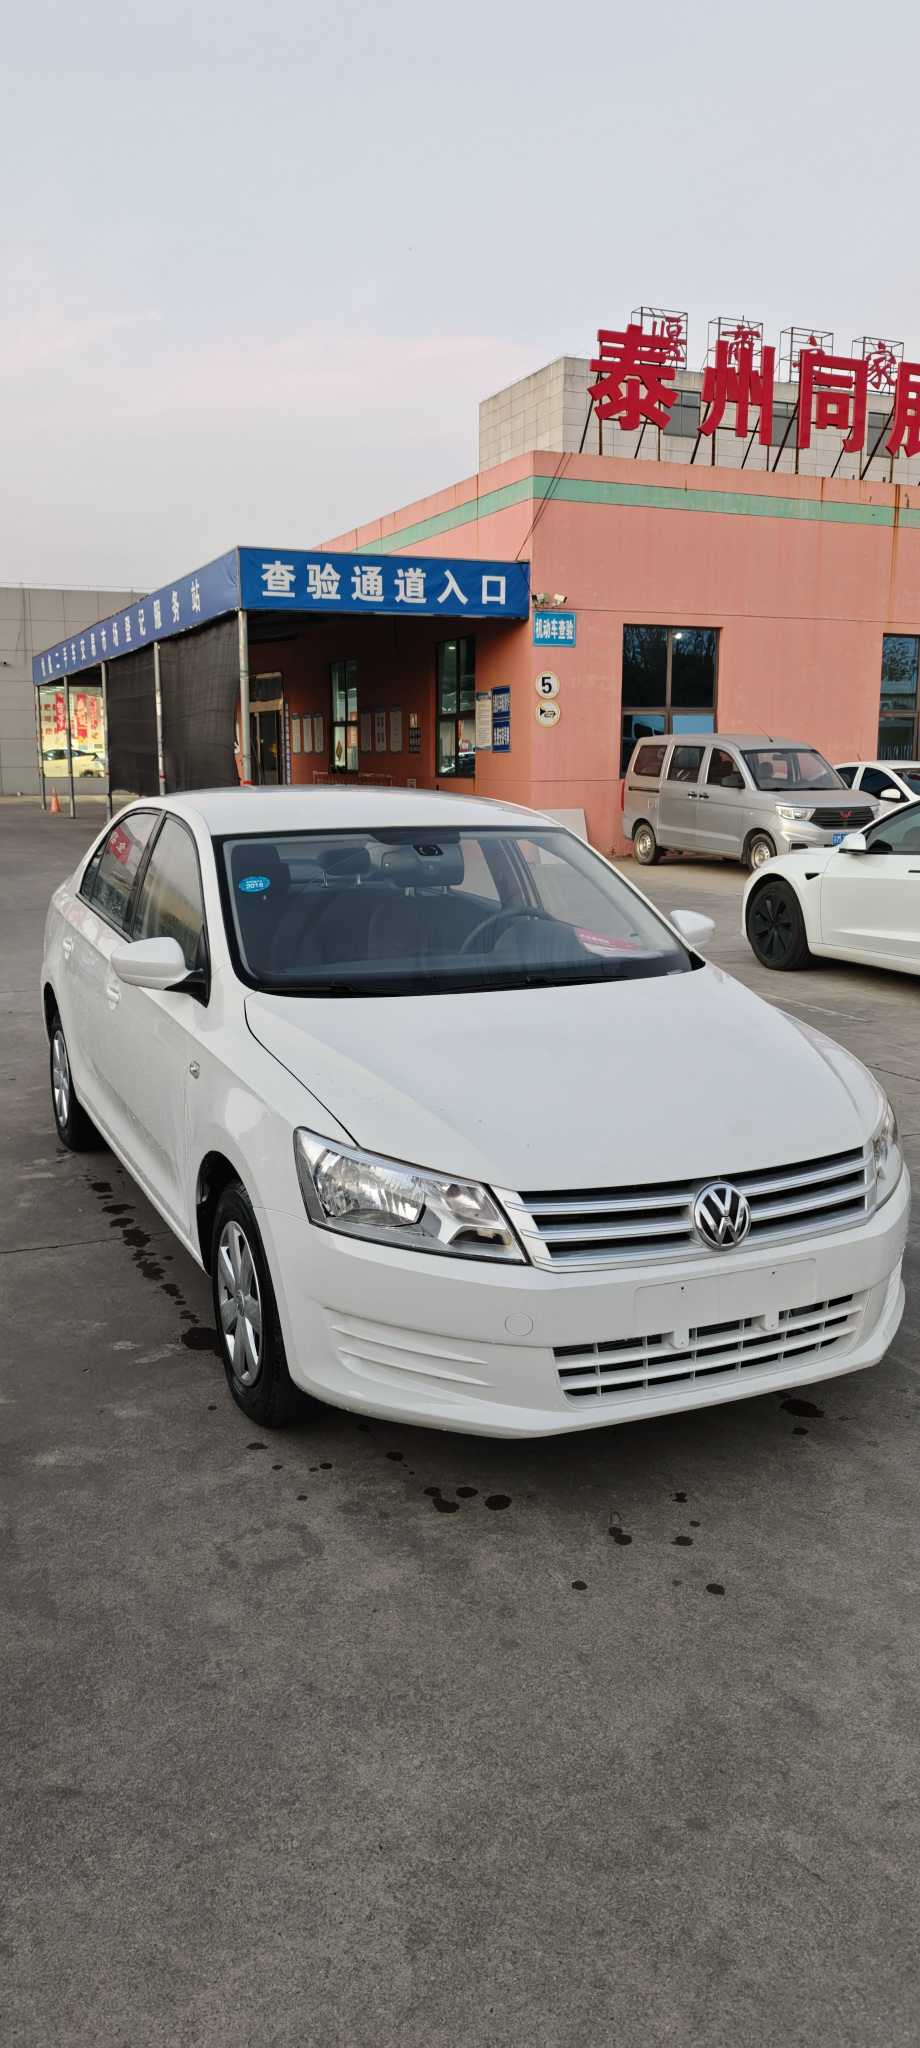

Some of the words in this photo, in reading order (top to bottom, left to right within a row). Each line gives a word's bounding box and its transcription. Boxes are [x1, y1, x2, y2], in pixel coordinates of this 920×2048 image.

[261, 560, 506, 605] 查验通道入口
[535, 618, 574, 640] 机动车查验
[541, 676, 552, 694] 5
[696, 1182, 749, 1248] VW
